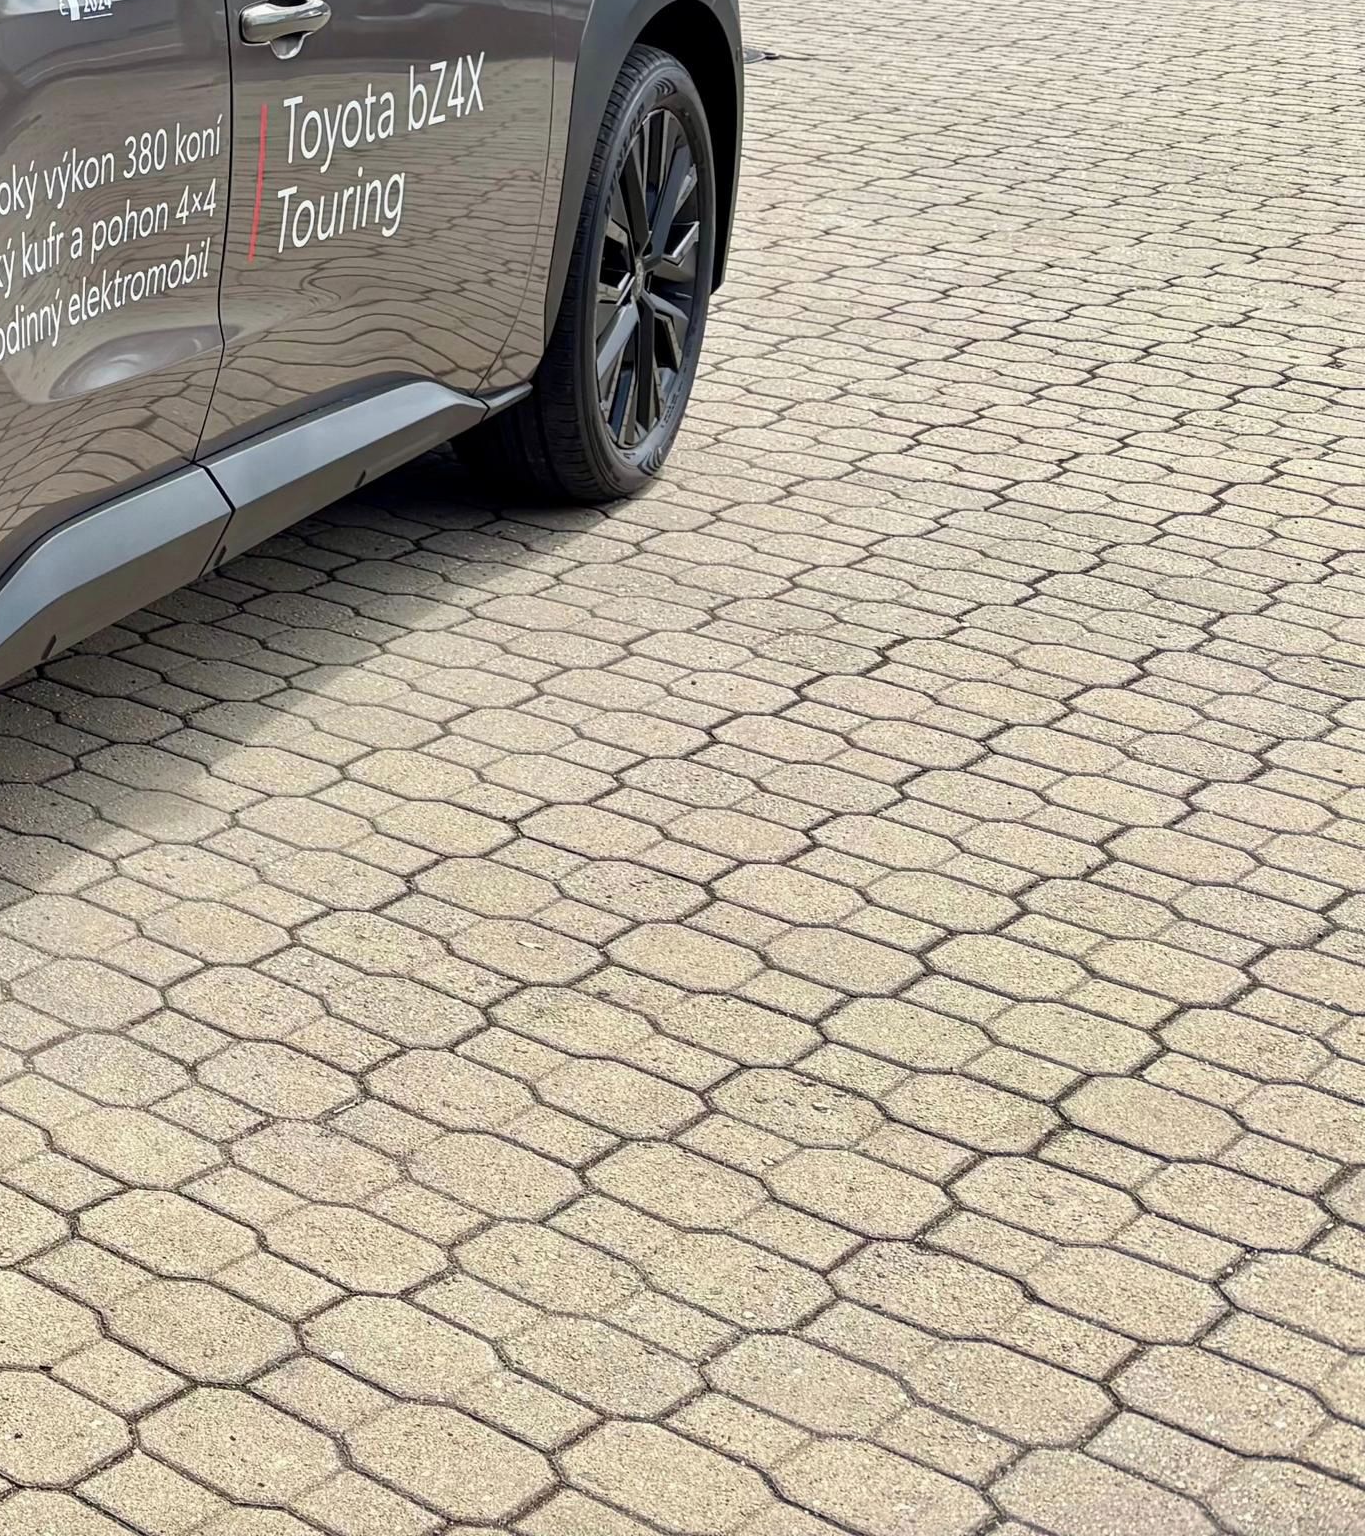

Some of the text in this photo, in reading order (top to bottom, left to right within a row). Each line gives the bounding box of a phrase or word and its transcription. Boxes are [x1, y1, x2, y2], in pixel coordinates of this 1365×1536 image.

[282, 50, 486, 175] Toyota bZ4X
[44, 146, 116, 210] výkon
[122, 127, 168, 180] 380
[174, 113, 223, 167] koní
[21, 220, 65, 278] kufr
[69, 226, 83, 260] a
[89, 198, 169, 265] pohon
[277, 165, 406, 255] Touring
[66, 236, 212, 327] elektromobil
